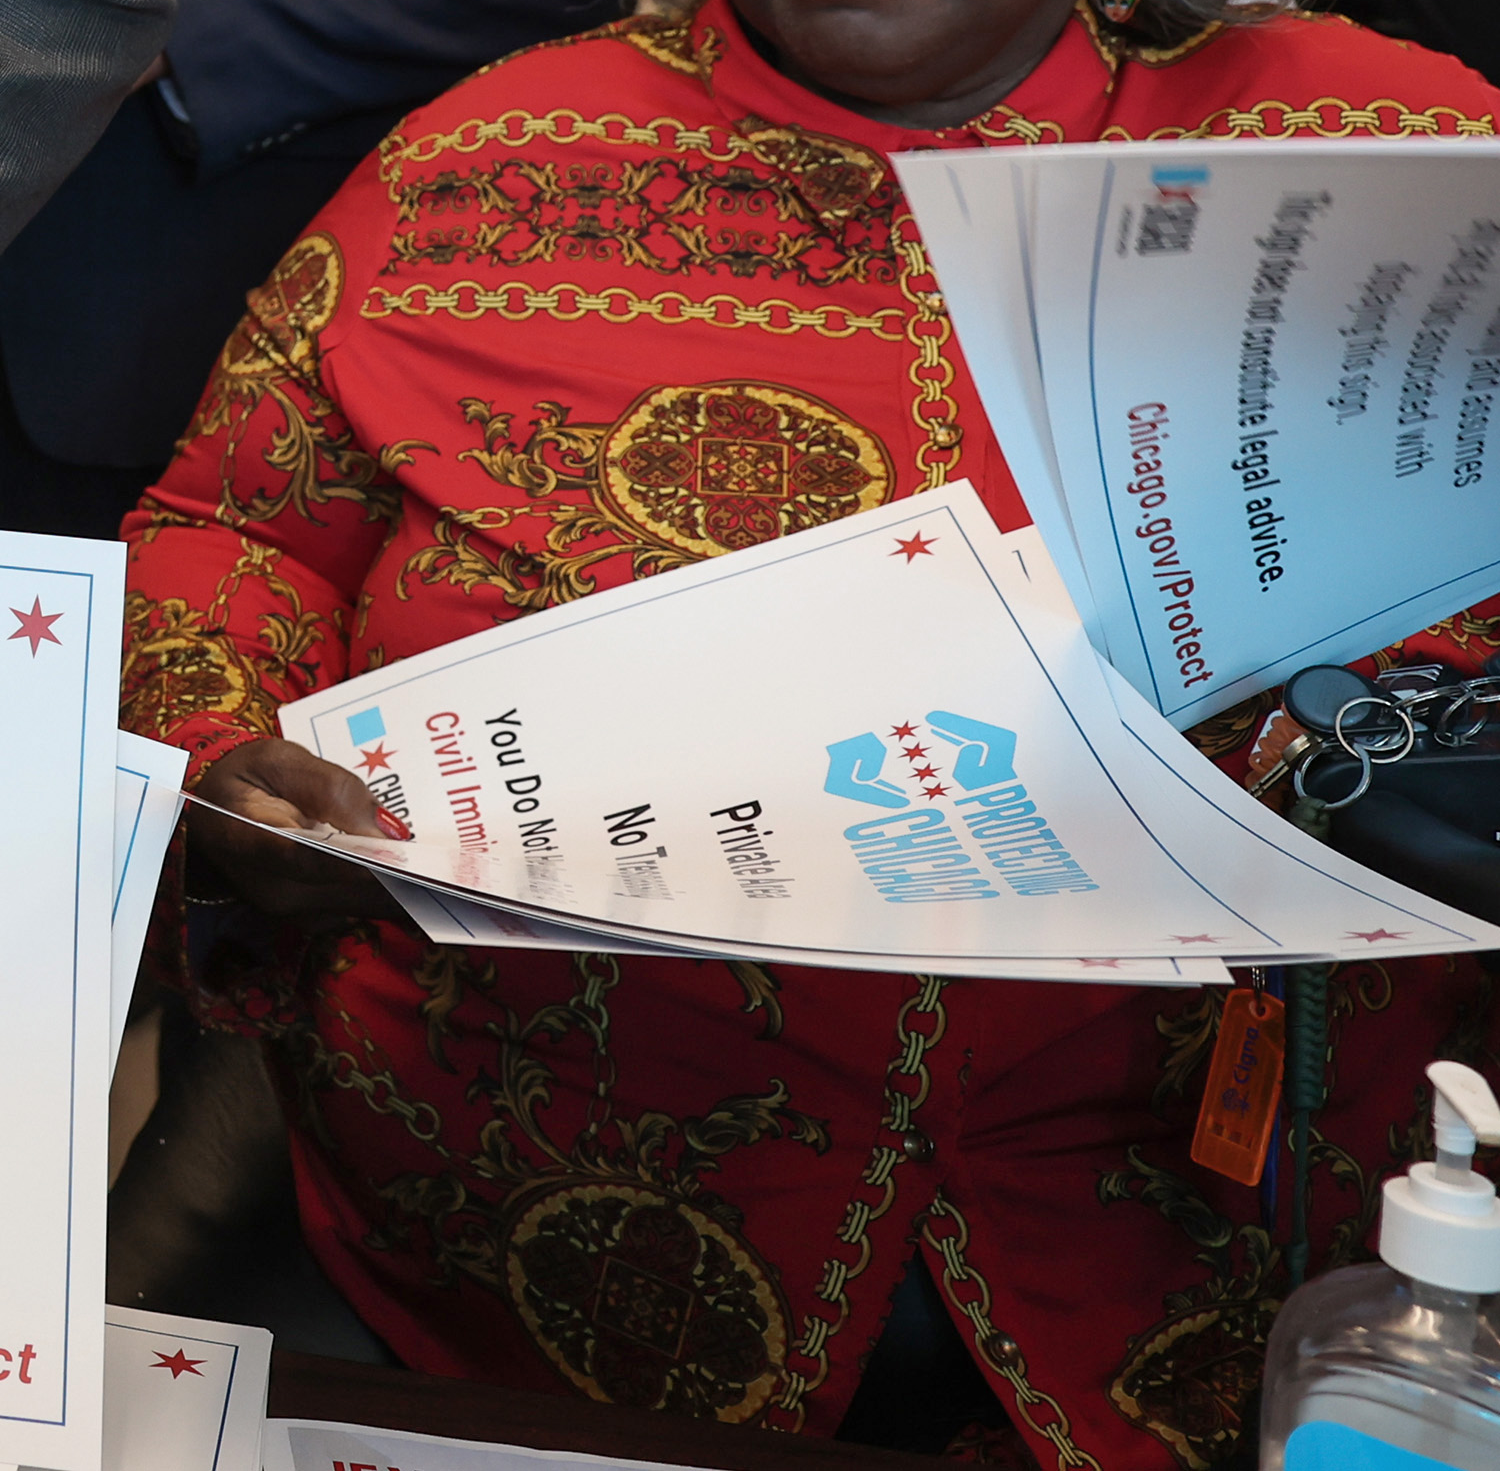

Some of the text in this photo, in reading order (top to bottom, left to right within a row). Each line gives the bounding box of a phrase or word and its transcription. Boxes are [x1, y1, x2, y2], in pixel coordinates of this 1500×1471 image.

[1231, 429, 1281, 492] legal
[1396, 428, 1434, 479] with
[1453, 393, 1495, 489] assumes
[1126, 401, 1214, 689] Chicago.gov/Protect
[1245, 496, 1287, 593] advice.
[425, 711, 477, 776] Civil
[485, 708, 525, 767] You
[505, 775, 542, 813] Do
[603, 803, 656, 846] No
[518, 818, 559, 853] Not
[710, 800, 781, 876] Private
[843, 808, 1000, 903] CHICAGO
[954, 784, 1100, 896] PROTECTING
